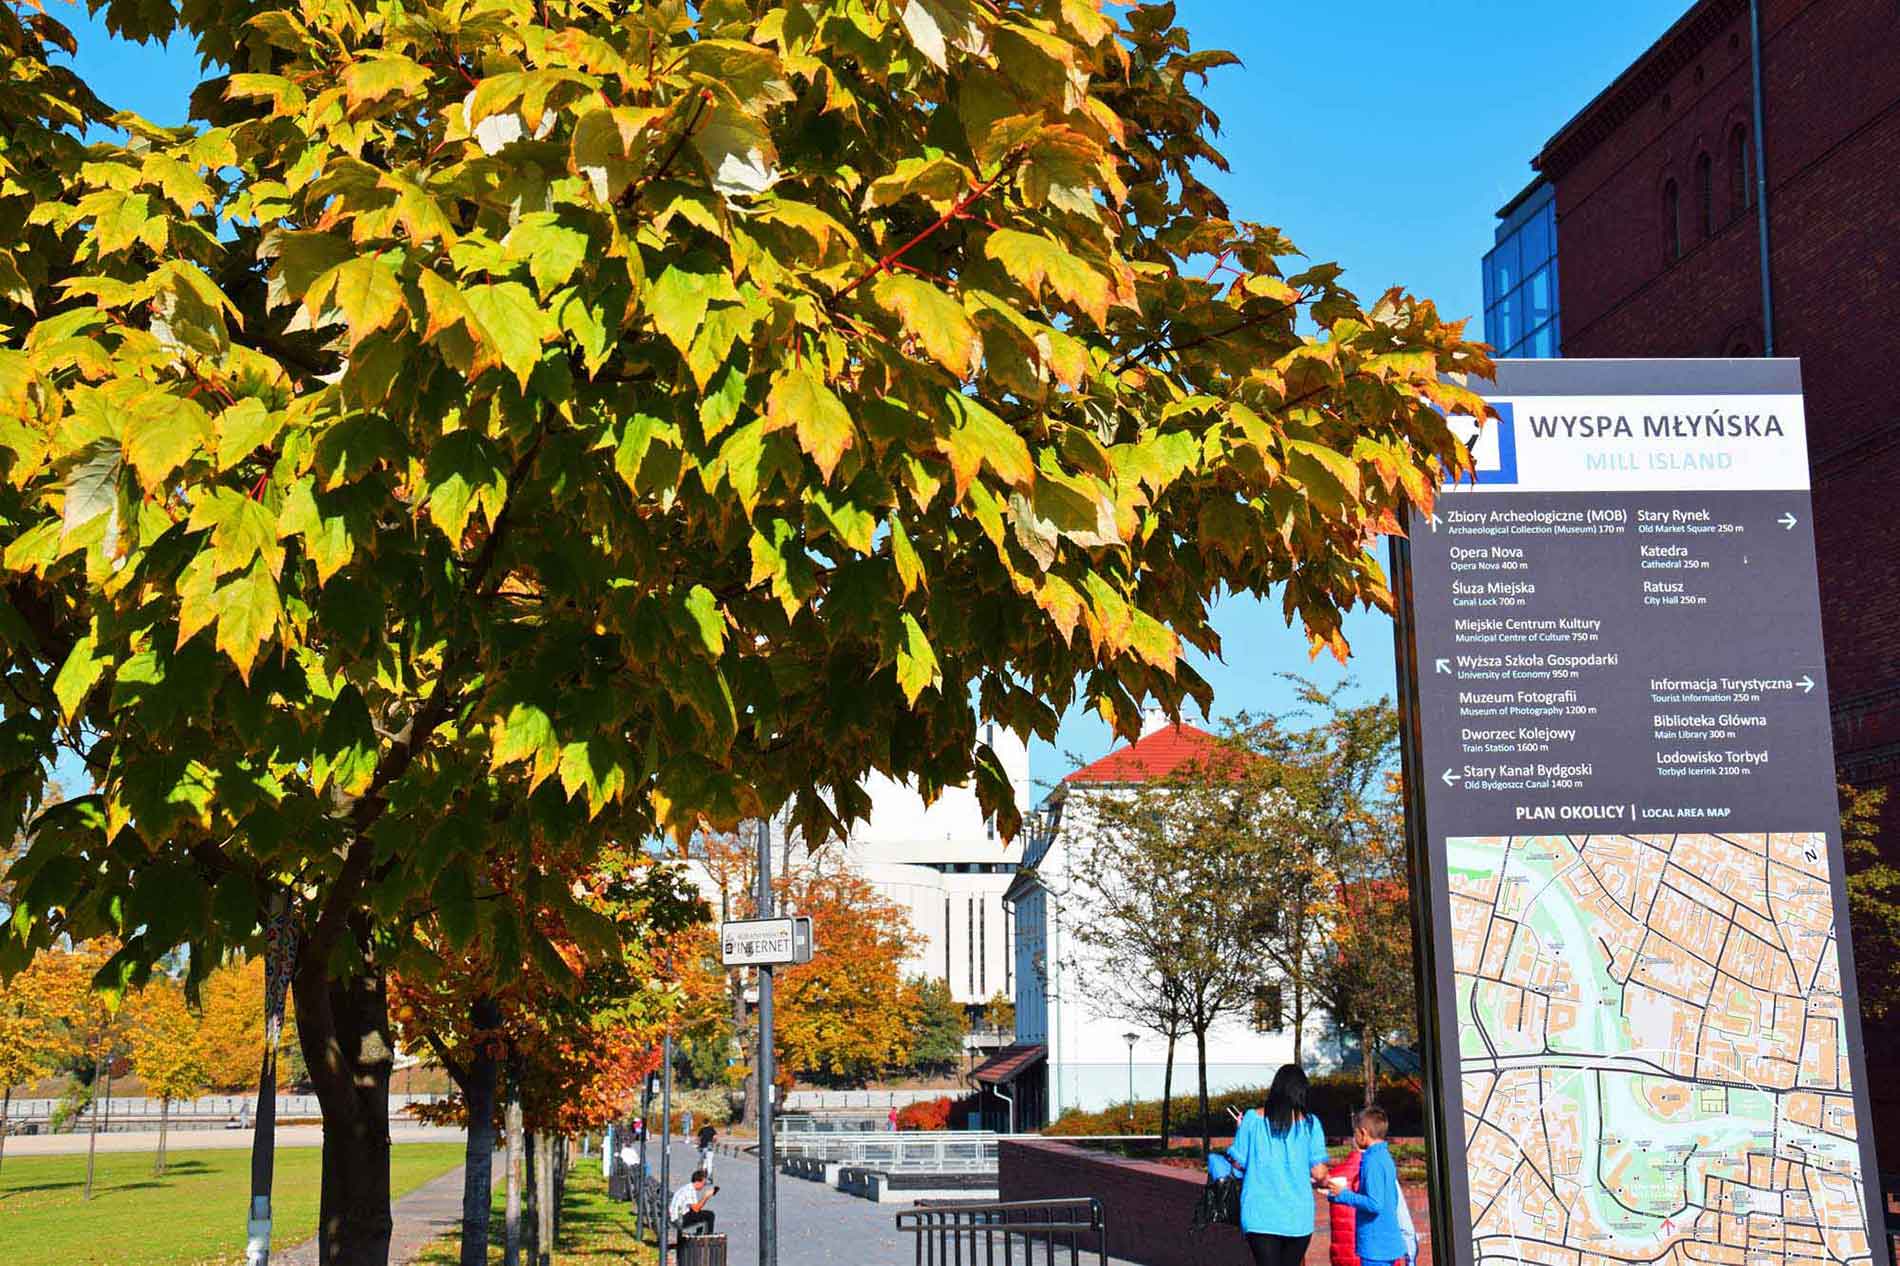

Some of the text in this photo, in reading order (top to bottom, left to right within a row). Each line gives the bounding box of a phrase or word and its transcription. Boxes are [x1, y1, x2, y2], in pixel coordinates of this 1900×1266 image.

[1529, 409, 1784, 438] WYSPA MŁYŃSKA
[1586, 452, 1732, 471] MILL ISLAND
[1447, 509, 1627, 524] Zbiory Archeologiczne (MOB)
[1637, 509, 1710, 522] Stary Rynek
[1448, 526, 1509, 535] Archaeological
[1511, 526, 1552, 534] Collection
[1554, 526, 1597, 534] (Museum)
[1599, 525, 1614, 533] 170
[1638, 525, 1654, 533] Old
[1687, 525, 1716, 533] Square
[1450, 547, 1524, 560] Opera Nova
[1640, 545, 1688, 556] Katedra
[1451, 562, 1477, 571] Opera
[1479, 562, 1500, 570] Nova
[1502, 561, 1518, 570] 400
[1641, 560, 1681, 568] Cathedral
[1683, 560, 1699, 568] 250
[1452, 579, 1535, 595] Śluza Miejska
[1644, 581, 1684, 592] Ratusz
[1453, 598, 1476, 606] Canal
[1479, 598, 1497, 606] Lock
[1499, 597, 1515, 606] 700
[1644, 596, 1660, 606] City
[1662, 596, 1678, 604] Hall
[1680, 596, 1696, 604] 250
[1455, 618, 1601, 632] Miejskie Centrum Kultury
[1456, 634, 1497, 643] Municipal
[1499, 634, 1526, 642] Centre
[1528, 633, 1538, 641] of
[1540, 633, 1570, 641] Culture
[1571, 633, 1588, 641] 750
[1456, 653, 1618, 669] Wyższa Szkoła Gospodarki
[1458, 670, 1500, 680] University
[1502, 670, 1511, 679] of
[1512, 670, 1551, 679] Economy
[1552, 670, 1568, 678] 950
[1651, 678, 1792, 692] Informacja Turystyczna
[1459, 690, 1576, 704] Muzeum Fotografii
[1652, 694, 1680, 702] Tourist
[1682, 694, 1732, 702] Information
[1733, 693, 1749, 702] 250
[1460, 708, 1497, 716] Museum
[1499, 707, 1508, 715] of
[1510, 706, 1563, 717] Photography
[1565, 706, 1587, 714] 1200
[1654, 714, 1767, 727] Biblioteka Główna
[1462, 728, 1576, 741] Dworzec Kolejowy
[1655, 731, 1677, 739] Main
[1678, 731, 1708, 740] Library
[1709, 730, 1725, 738] 300
[1463, 744, 1483, 752] Train
[1485, 744, 1515, 752] Station
[1517, 743, 1538, 752] 1600
[1657, 750, 1769, 765] Lodowisko Torbyd
[1463, 763, 1592, 778] Stary Kanał Bydgoski
[1658, 768, 1687, 777] Torbyd
[1688, 767, 1716, 775] Icerink
[1718, 766, 1739, 775] 2100
[1464, 781, 1480, 789] Old
[1482, 781, 1524, 790] Bydgoszcz
[1525, 780, 1549, 788] Canal
[1551, 780, 1572, 788] 1400
[1516, 805, 1732, 820] PLAN OKOLICY LOCAL AREA MAP
